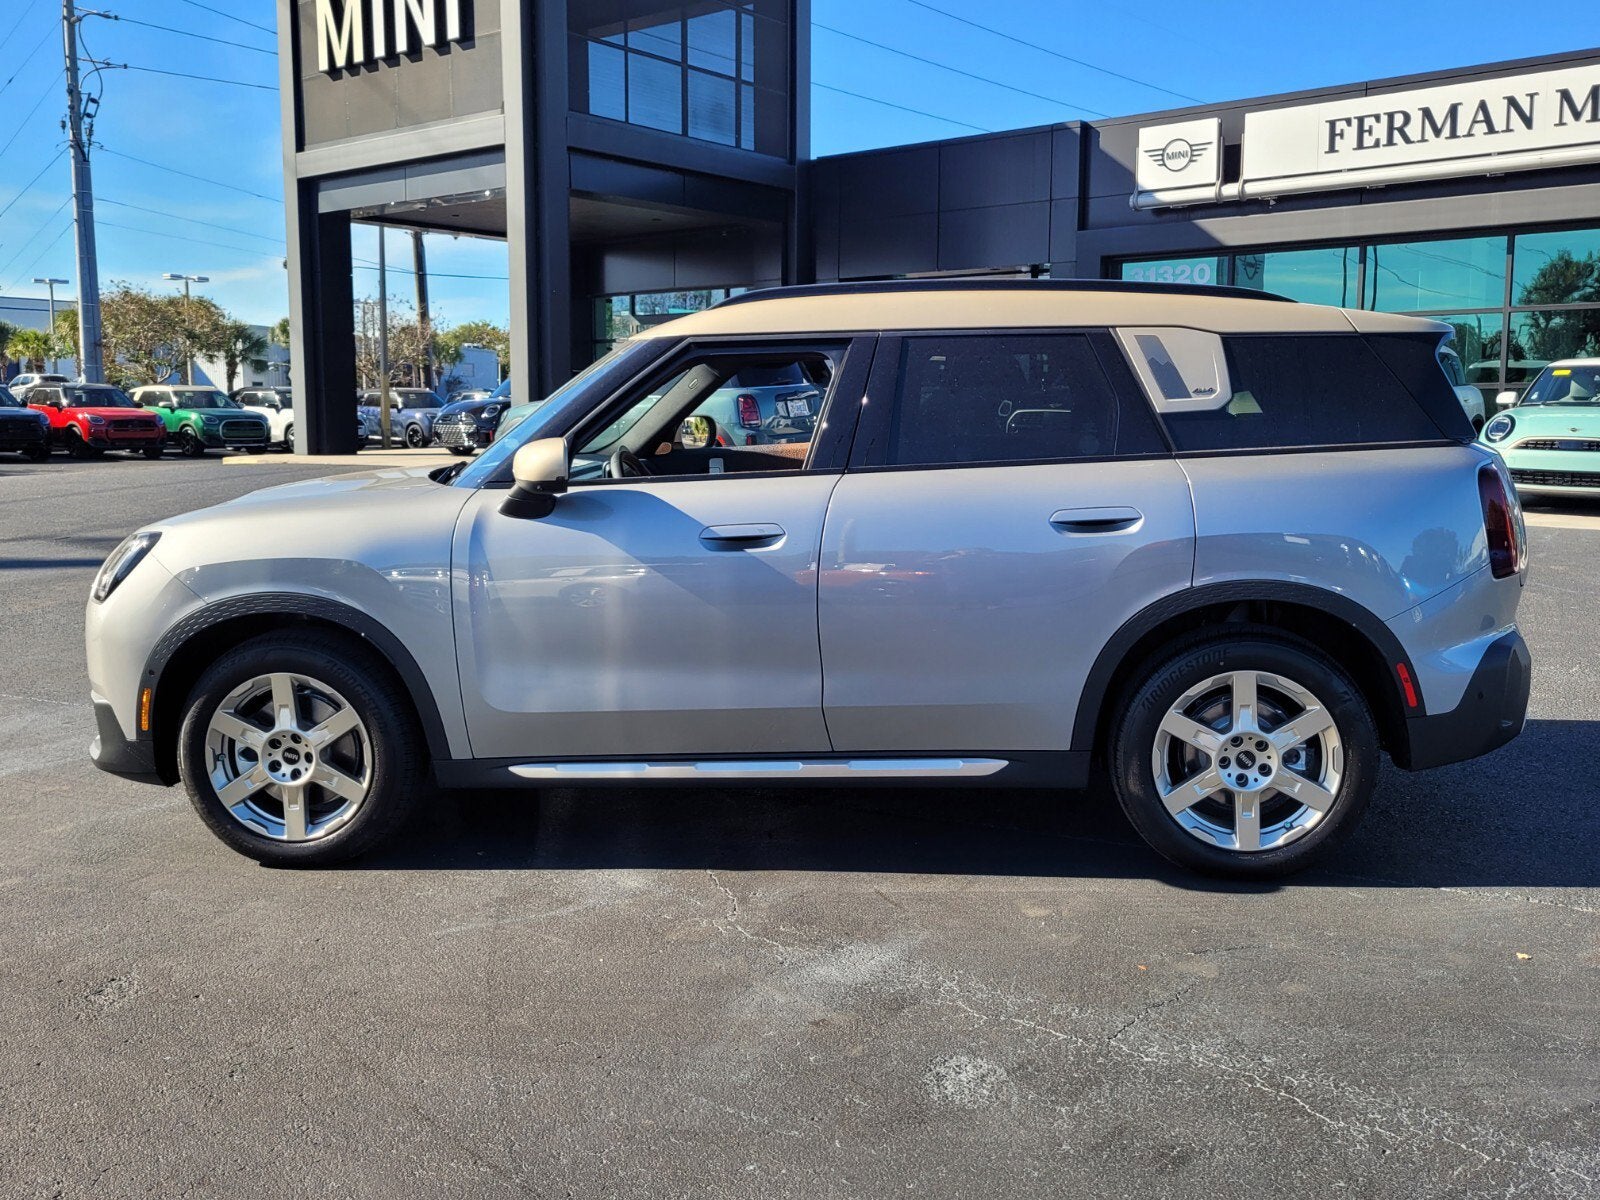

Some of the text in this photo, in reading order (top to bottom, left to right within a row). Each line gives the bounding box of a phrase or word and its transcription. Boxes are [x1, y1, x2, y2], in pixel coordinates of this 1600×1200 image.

[316, 0, 460, 72] MINI
[1324, 92, 1539, 154] FERMAN
[1165, 149, 1190, 161] MINI
[1129, 263, 1211, 285] 31320
[284, 751, 299, 760] MINI
